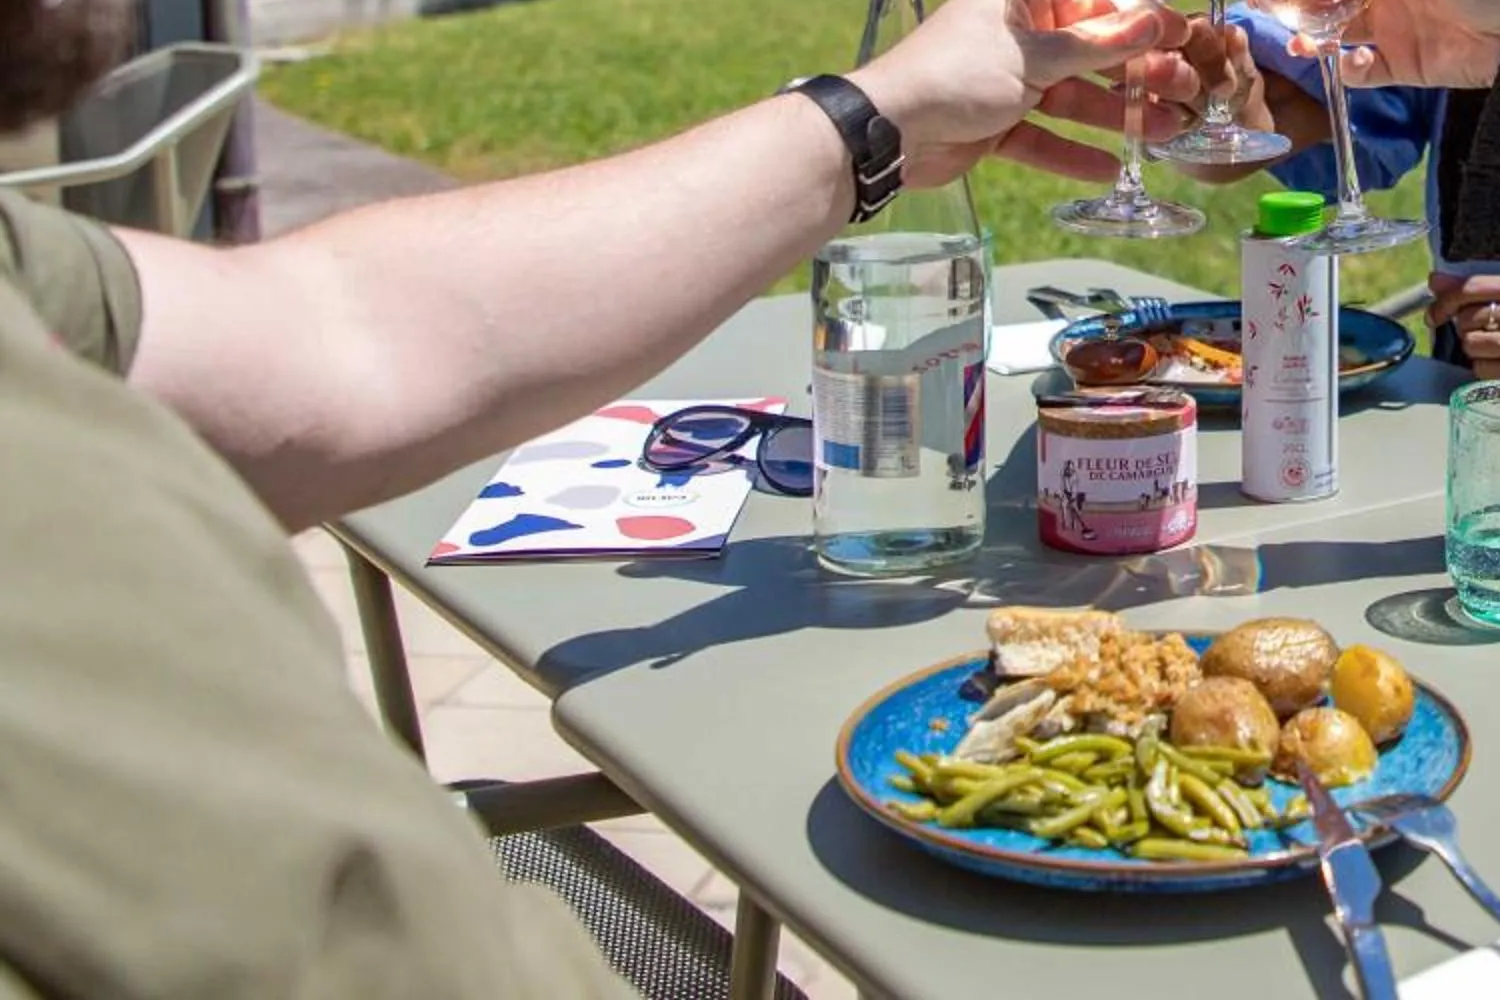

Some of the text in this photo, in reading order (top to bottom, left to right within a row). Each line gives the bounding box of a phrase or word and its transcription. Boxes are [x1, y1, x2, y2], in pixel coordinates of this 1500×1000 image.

[1077, 456, 1130, 471] FLEUR
[1135, 457, 1156, 470] DE
[1088, 471, 1107, 481] DE
